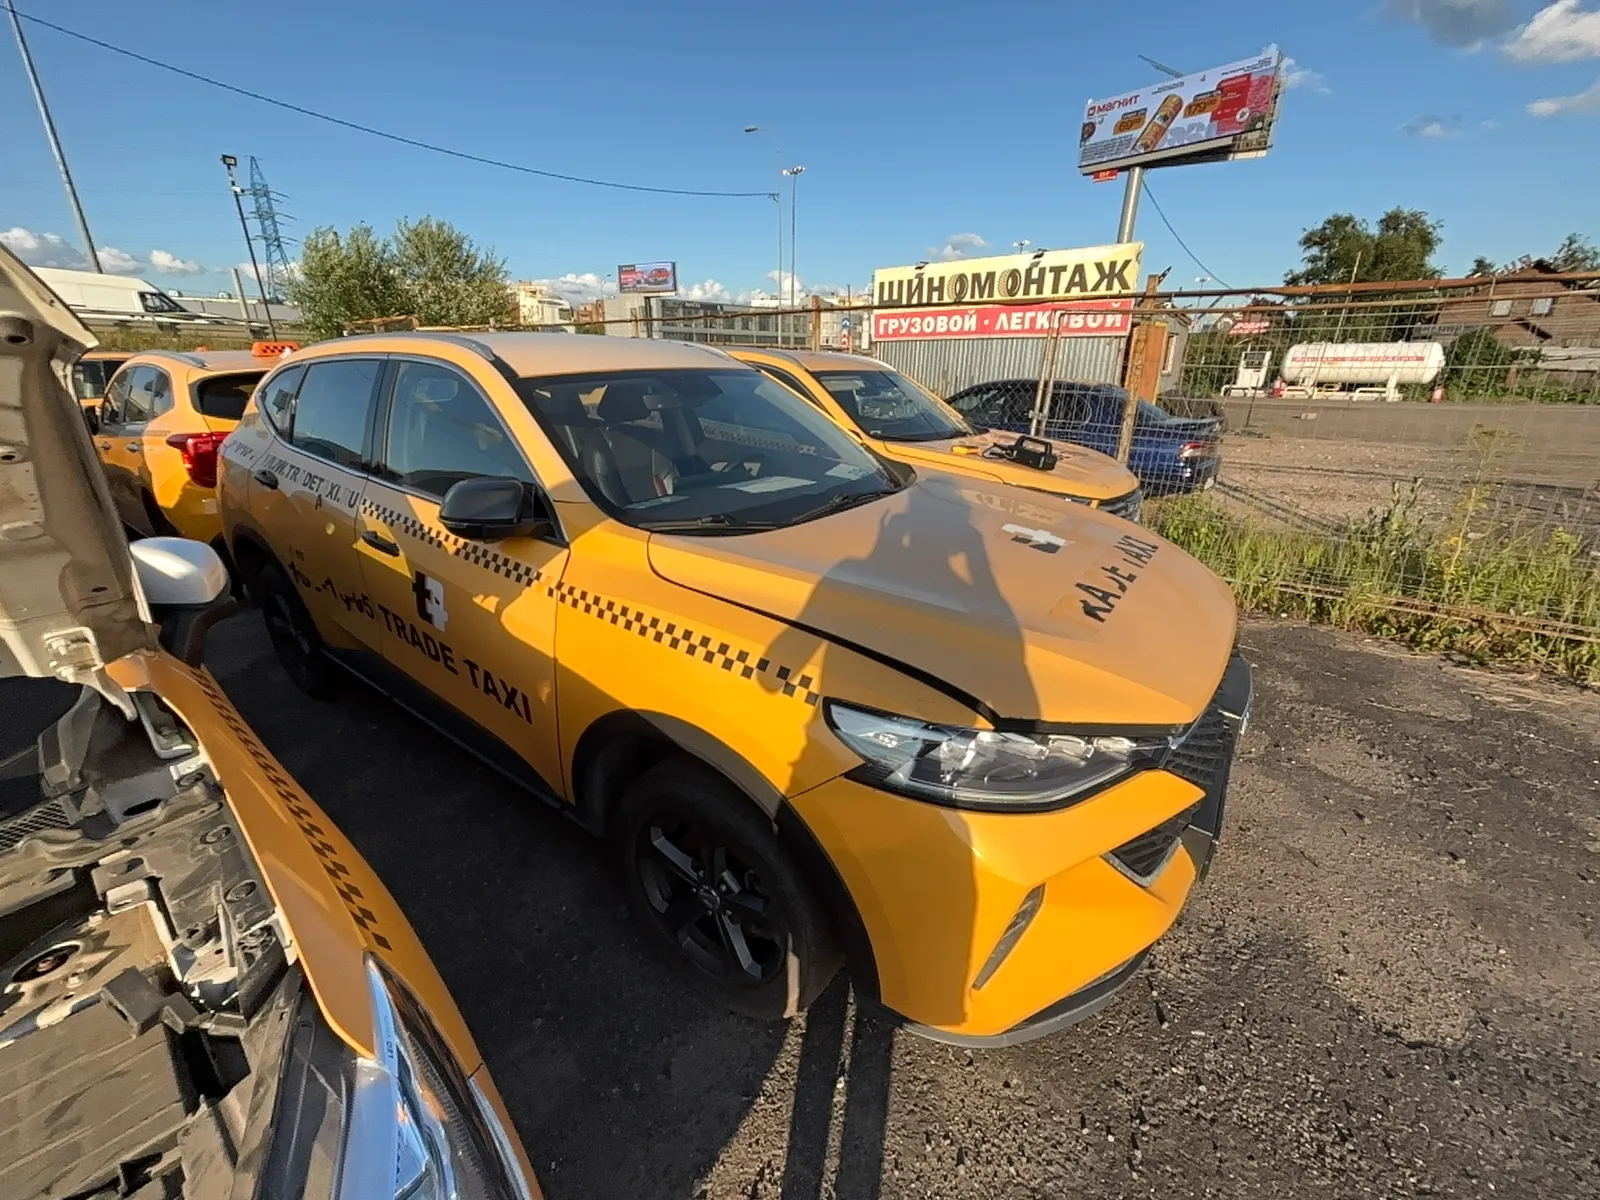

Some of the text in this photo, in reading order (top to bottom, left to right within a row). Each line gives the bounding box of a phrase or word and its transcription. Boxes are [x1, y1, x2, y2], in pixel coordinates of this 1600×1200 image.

[878, 259, 1132, 306] ШИНОМОНТАЖ
[879, 309, 976, 335] ГРУЗОВОЙ
[376, 603, 533, 726] TRADE TAXI
